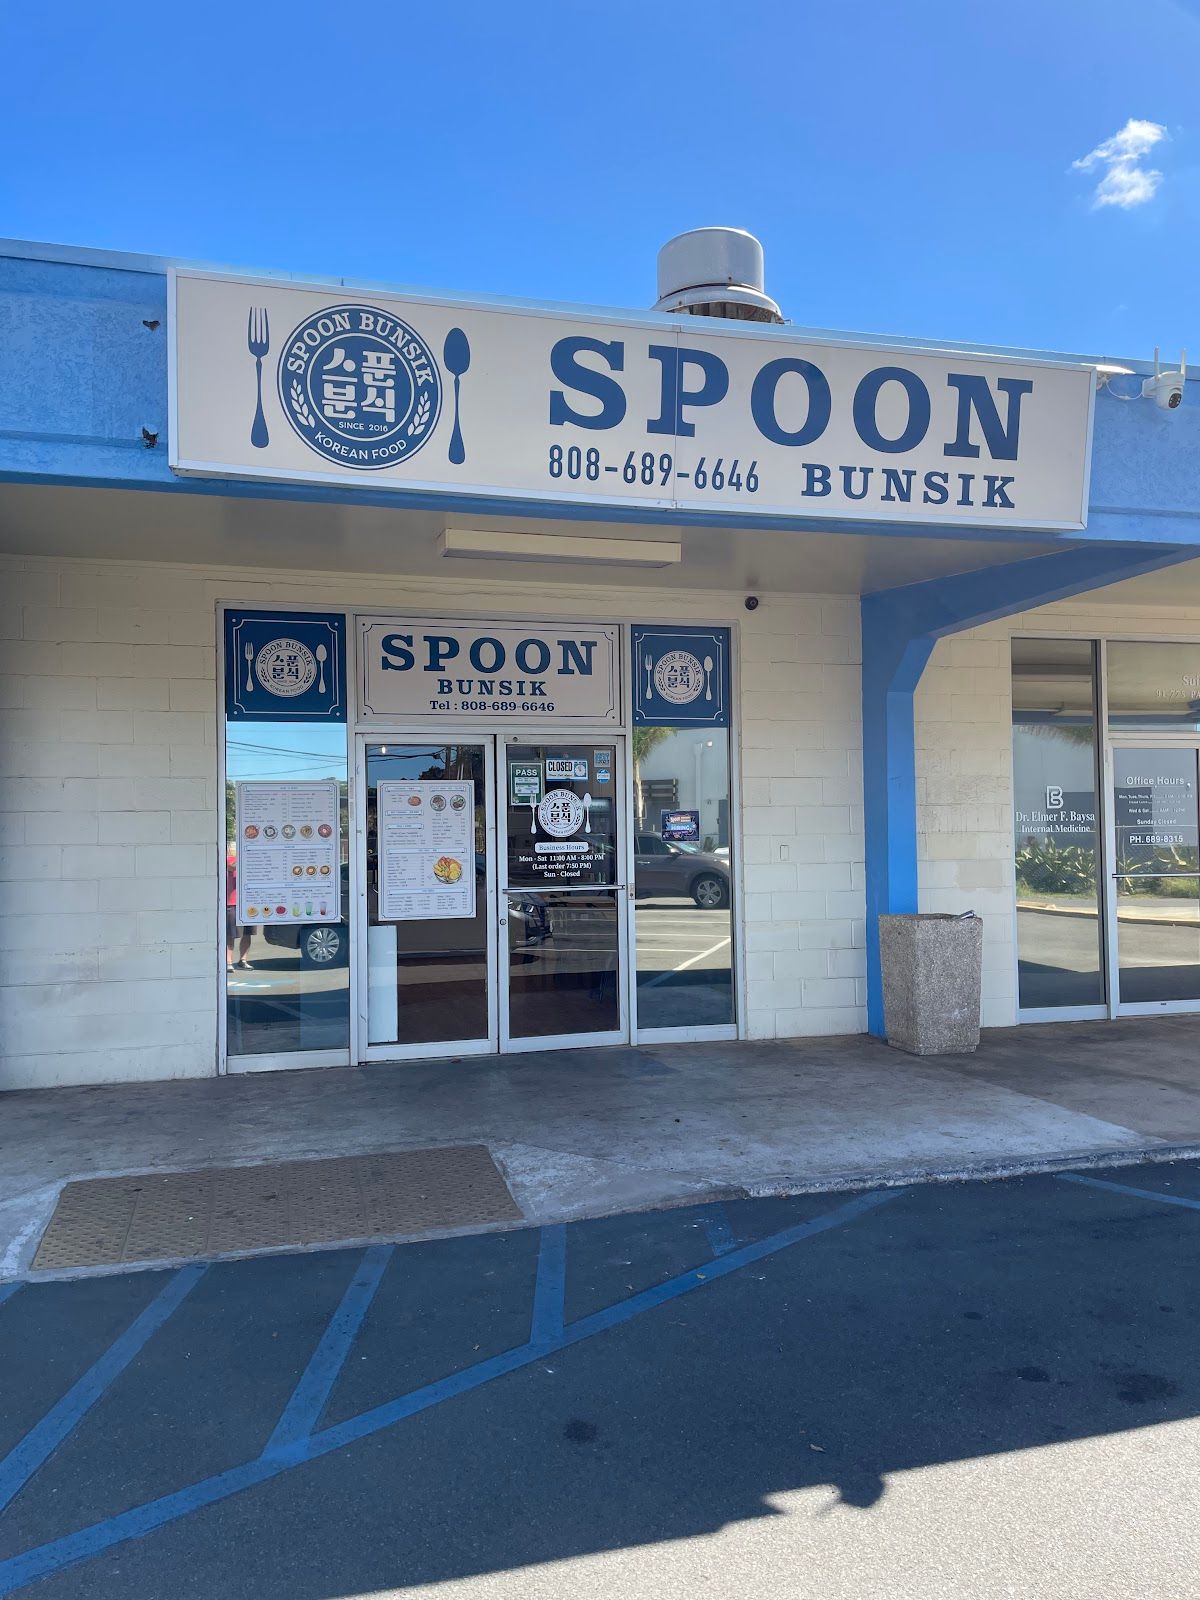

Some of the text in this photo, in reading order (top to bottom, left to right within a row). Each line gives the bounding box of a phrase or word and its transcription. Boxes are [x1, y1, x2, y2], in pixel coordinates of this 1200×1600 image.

[286, 312, 434, 386] SPOON BUNSIK
[322, 347, 396, 386] 스푼
[322, 383, 396, 423] 분식
[549, 336, 1033, 461] SPOON
[338, 421, 388, 432] SINCE 2016
[314, 431, 407, 460] KOREAN FOOD
[549, 444, 759, 493] 808-689-6646
[801, 463, 1015, 509] BUNSIK
[260, 641, 313, 666] SPOON BUNSIK
[381, 634, 597, 675] SPOON
[437, 679, 547, 696] BUNSIK
[430, 700, 450, 710] Tel
[461, 701, 555, 712] 808-689-6646
[548, 761, 573, 772] CLOSED
[1126, 776, 1185, 785] Office Hours
[1015, 811, 1095, 823] Dr. Elmer F. Baysa
[1021, 824, 1090, 833] Internal Medicine
[1129, 835, 1184, 844] PH. 689-8315
[560, 870, 581, 878] Closed
